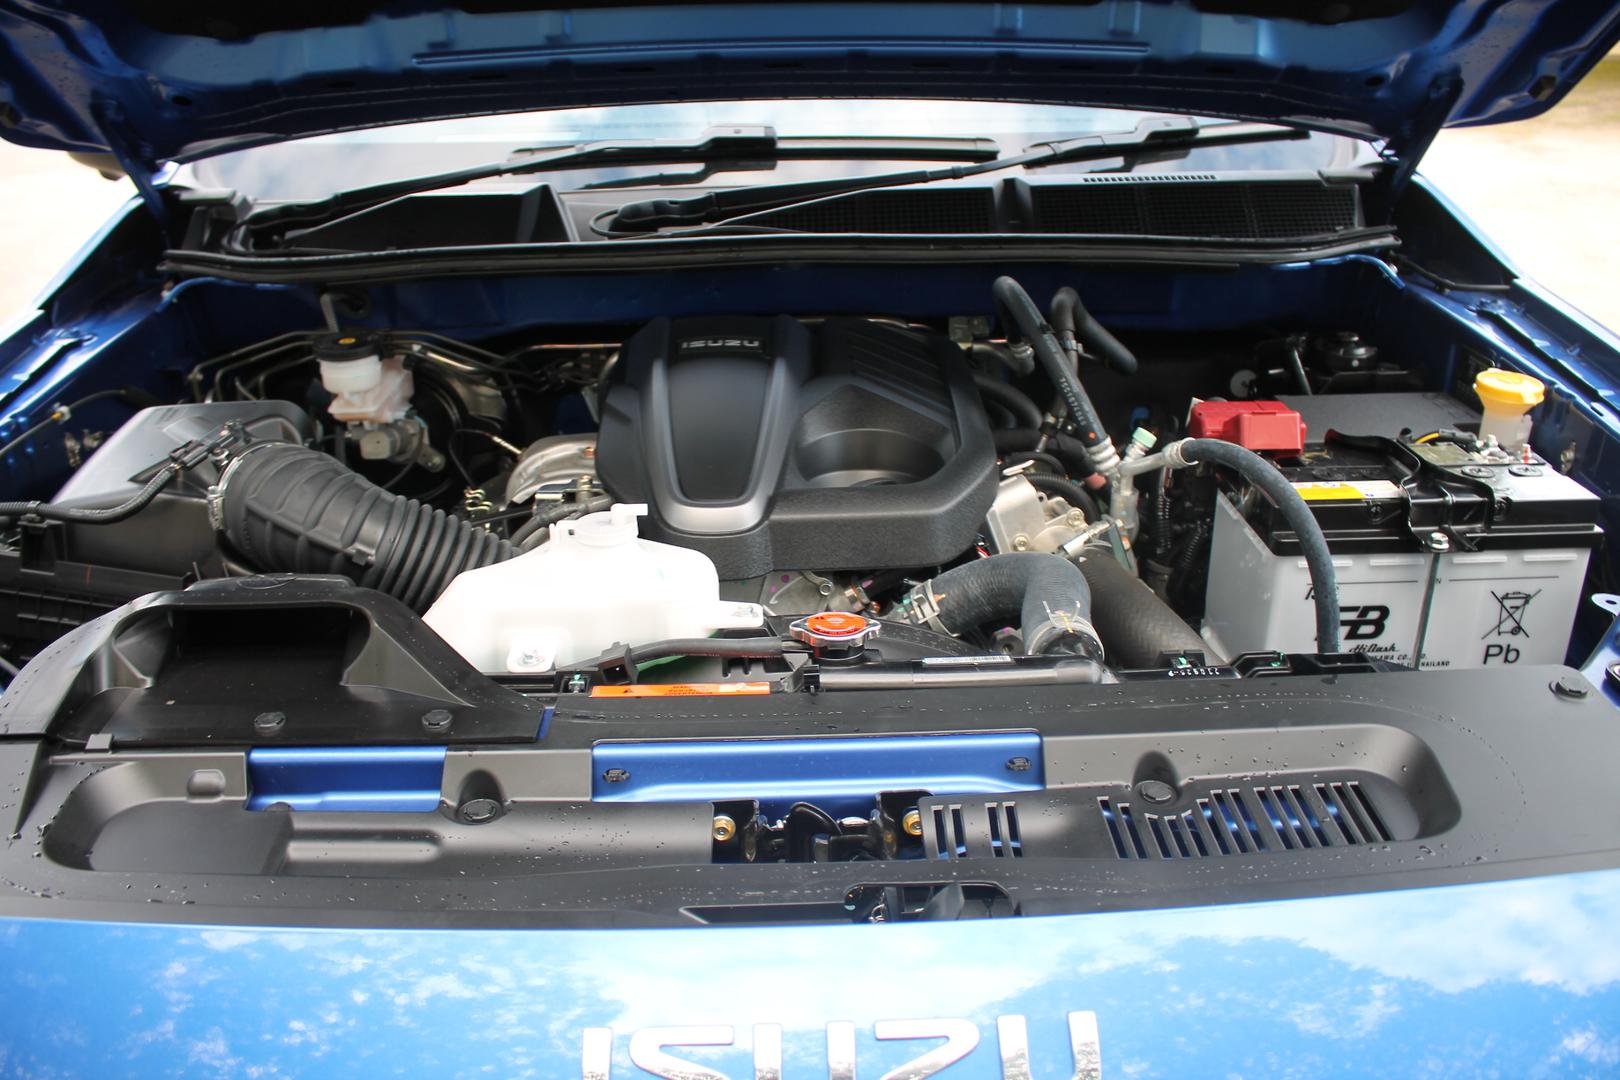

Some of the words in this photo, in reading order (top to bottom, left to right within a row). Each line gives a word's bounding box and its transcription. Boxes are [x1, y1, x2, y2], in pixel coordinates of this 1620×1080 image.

[681, 338, 761, 349] ISUZU
[1483, 644, 1520, 665] Pb
[582, 1009, 1103, 1080] ISUZU
